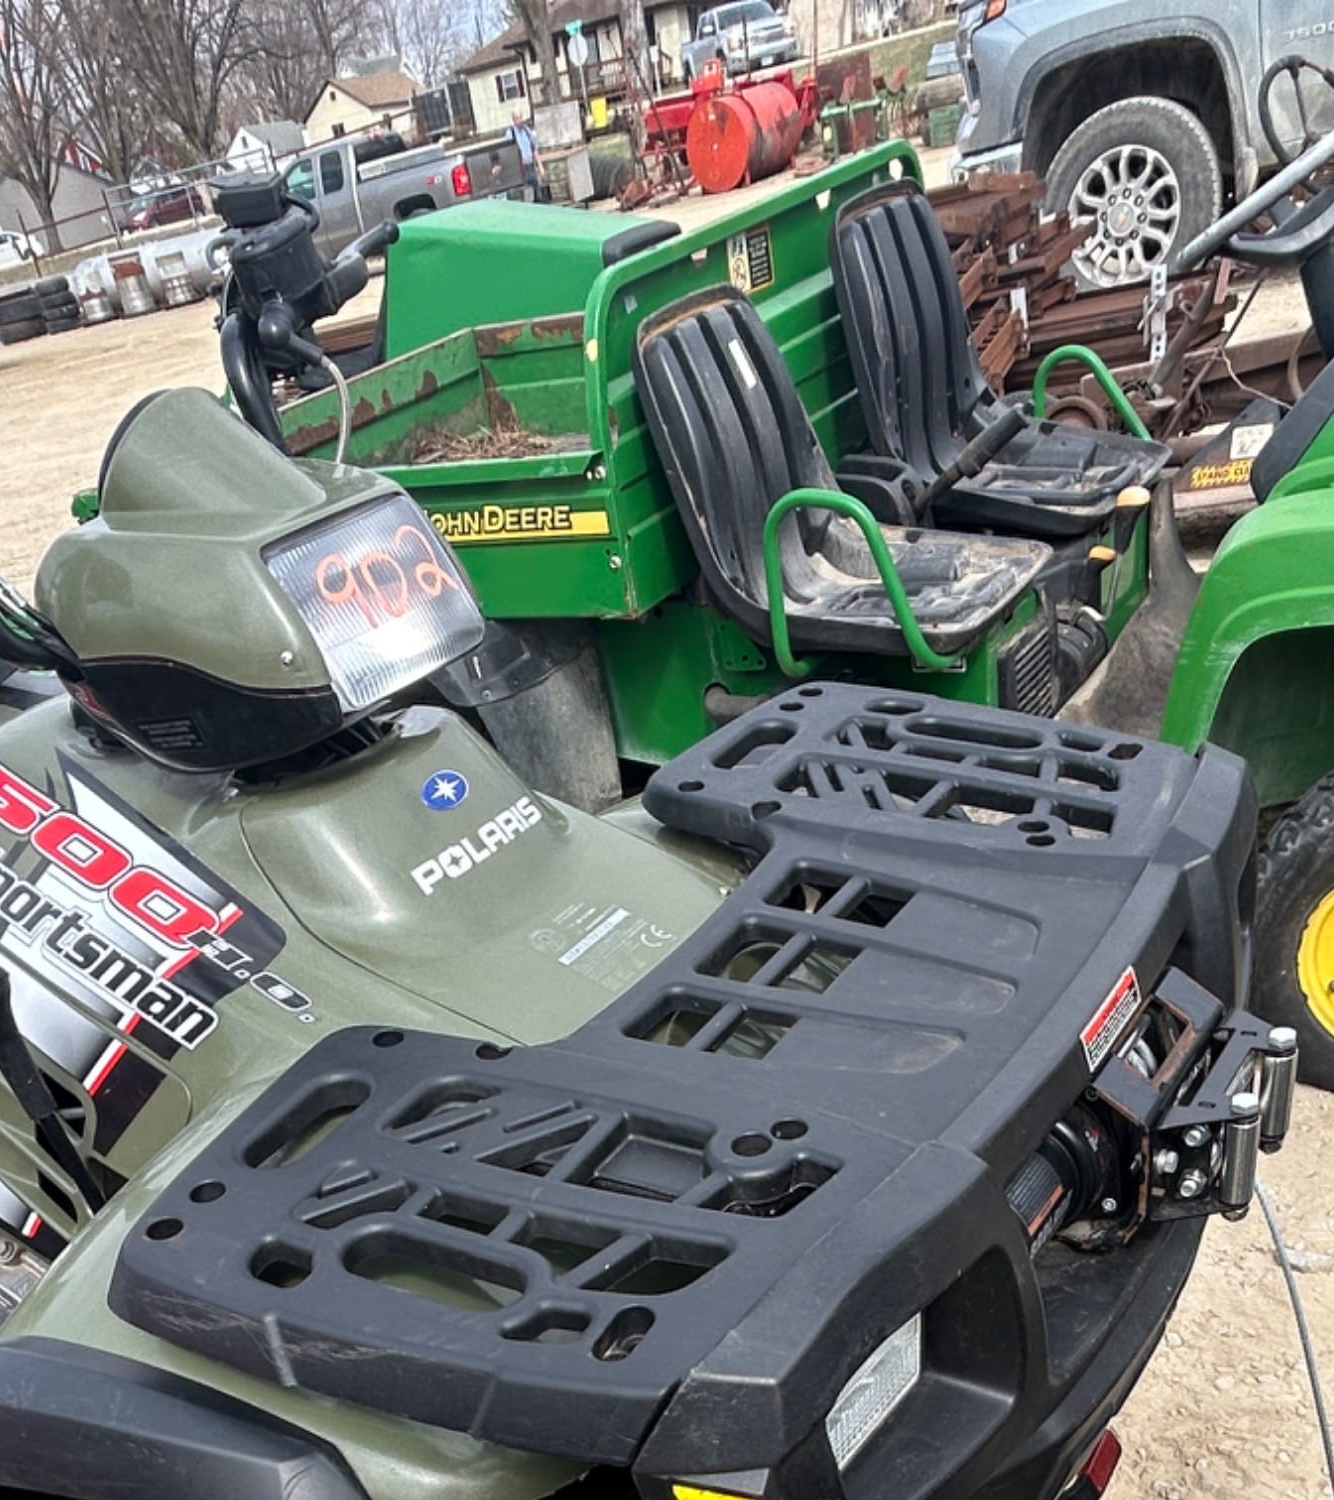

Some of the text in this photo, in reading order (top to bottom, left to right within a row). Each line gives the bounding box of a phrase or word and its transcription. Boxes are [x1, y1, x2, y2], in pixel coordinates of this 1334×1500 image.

[423, 504, 571, 536] OHN DEERE
[316, 524, 460, 629] 902
[410, 796, 543, 896] POLARIS
